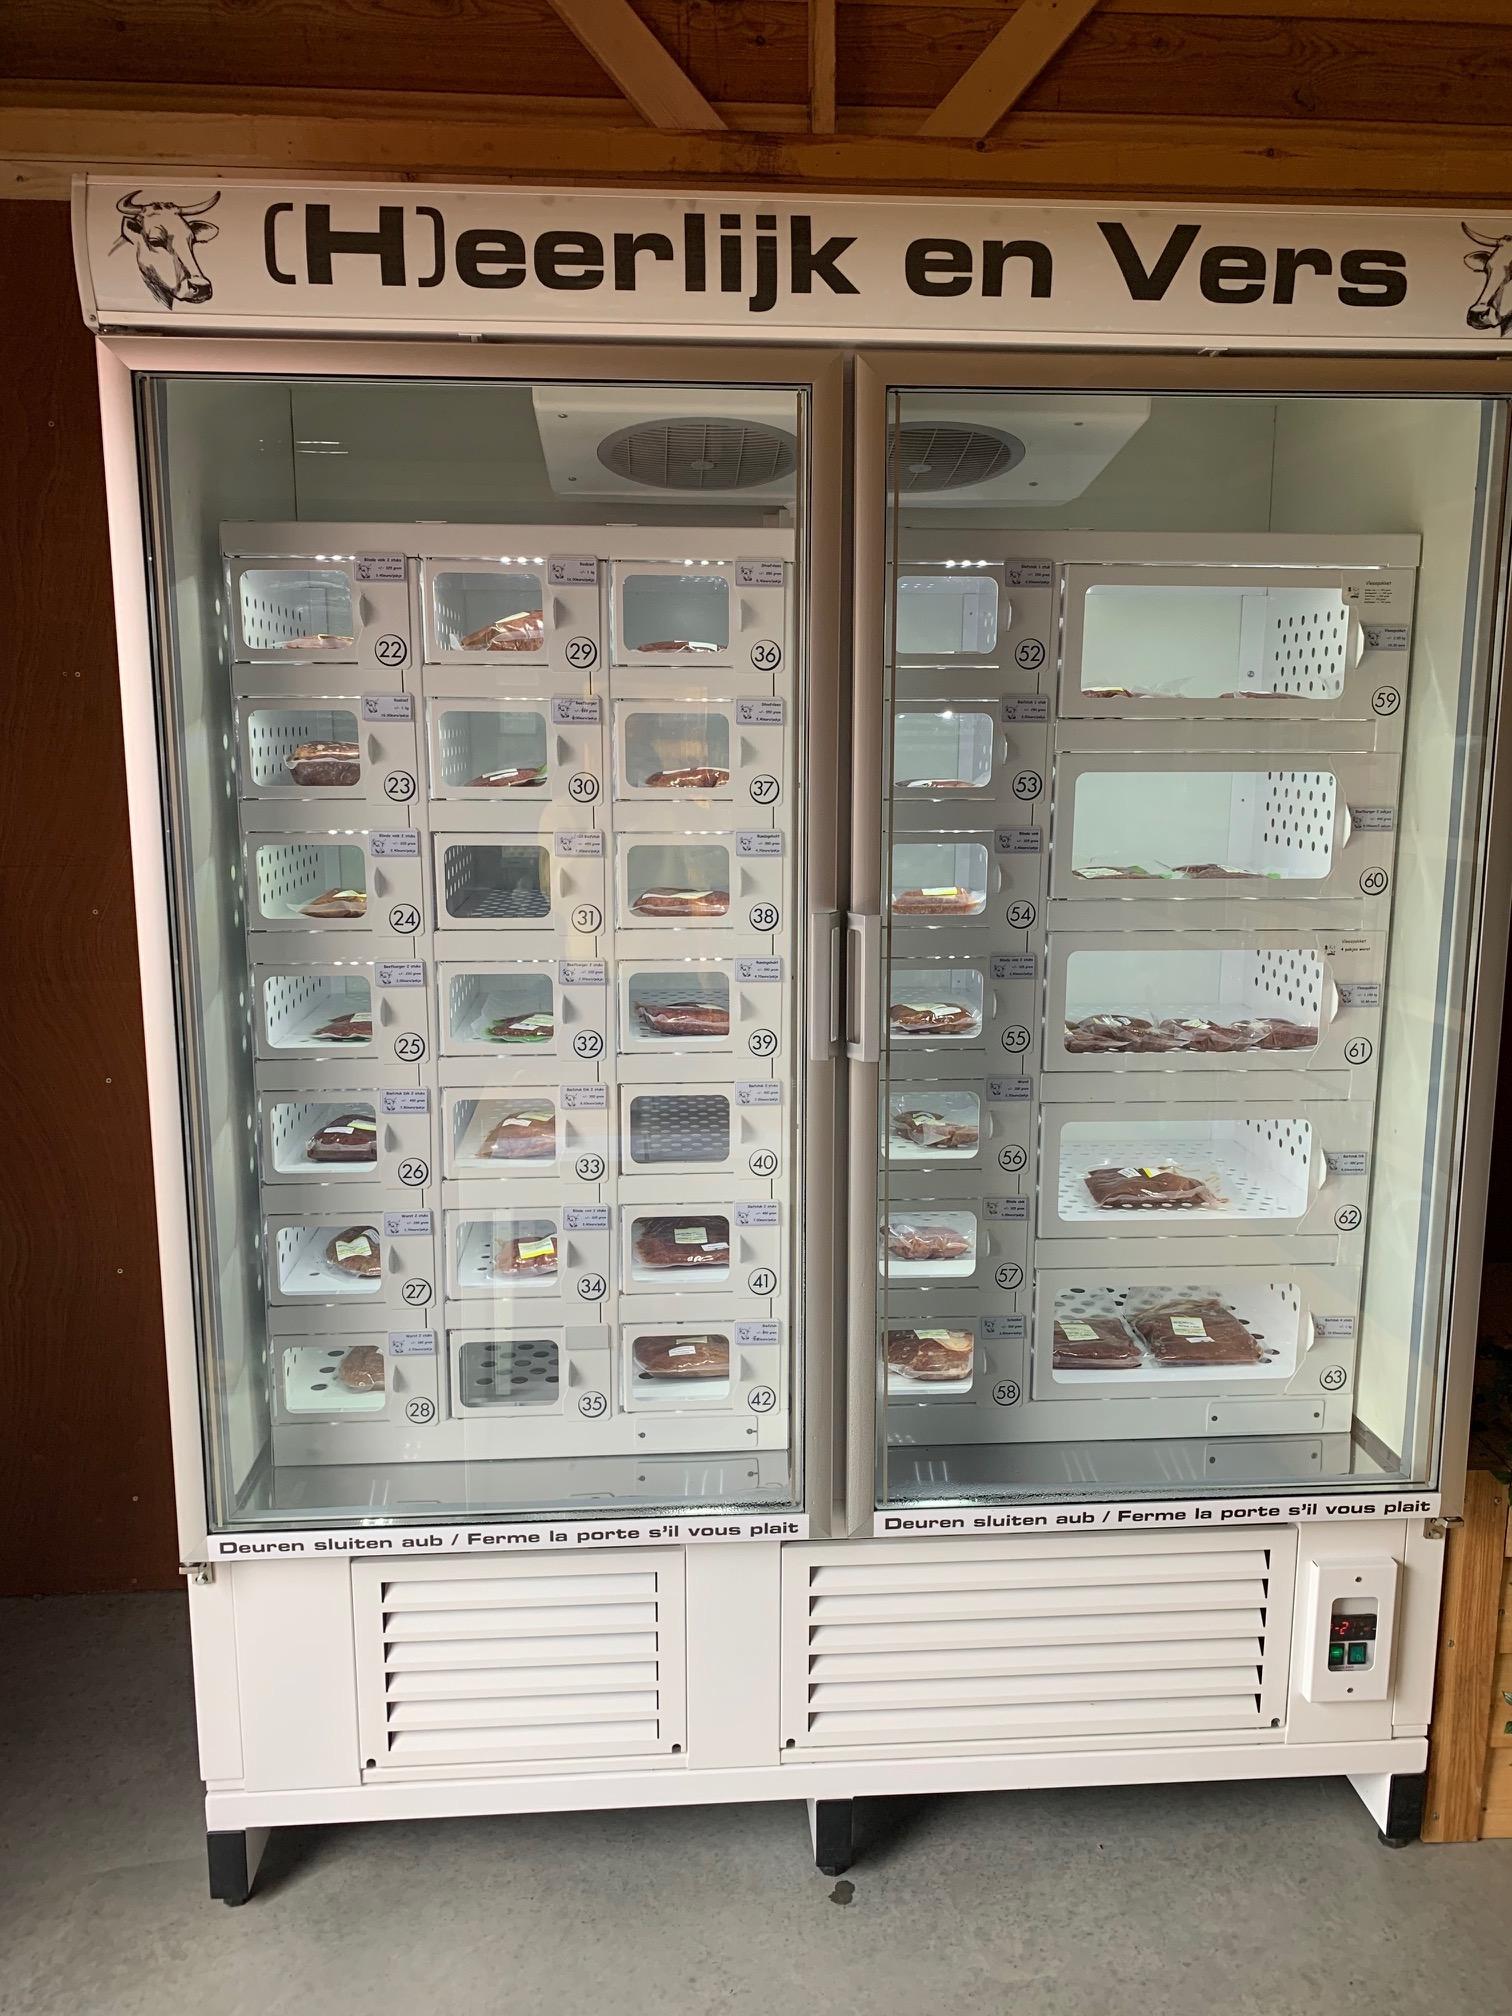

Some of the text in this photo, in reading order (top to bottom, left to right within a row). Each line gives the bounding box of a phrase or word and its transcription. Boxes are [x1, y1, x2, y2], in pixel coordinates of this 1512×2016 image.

[904, 236, 1053, 298] en
[1096, 221, 1408, 308] Vers
[378, 639, 402, 658] 22
[570, 641, 592, 660] 29
[754, 644, 776, 663] 36
[1018, 644, 1041, 662] 52
[1374, 691, 1396, 708] 59
[388, 775, 410, 794] 23
[572, 777, 595, 796] 30
[753, 779, 774, 796] 37
[1016, 775, 1038, 793] 53
[1364, 871, 1384, 888] 60
[393, 909, 416, 926] 24
[577, 909, 594, 926] 31
[753, 907, 774, 924] 38
[1010, 905, 1032, 922] 54
[398, 1037, 420, 1054] 25
[577, 1035, 598, 1052] 32
[752, 1033, 773, 1050] 39
[1005, 1029, 1026, 1046] 55
[1349, 1041, 1365, 1058] 61
[579, 1157, 600, 1174] 33
[752, 1154, 774, 1170] 40
[1002, 1149, 1022, 1165] 56
[402, 1163, 424, 1179] 26
[1338, 1209, 1358, 1224] 62
[752, 1273, 768, 1288] 41
[998, 1267, 1019, 1283] 57
[406, 1283, 426, 1299] 27
[581, 1277, 602, 1294] 34
[1324, 1369, 1342, 1384] 63
[751, 1390, 771, 1406] 42
[996, 1383, 1016, 1400] 58
[410, 1401, 430, 1417] 28
[582, 1395, 602, 1411] 35
[885, 1517, 964, 1529] Deuren
[974, 1514, 1047, 1527] sluiten
[1056, 1511, 1095, 1524] aub
[1118, 1509, 1186, 1522] Ferme
[1195, 1508, 1212, 1520] la
[1221, 1505, 1280, 1521] porte
[1288, 1503, 1317, 1516] s'il
[1326, 1504, 1376, 1515] vous
[1384, 1500, 1431, 1515] plait
[219, 1541, 304, 1554] Deuren
[314, 1537, 393, 1551] sluiten
[402, 1534, 443, 1548] aub
[468, 1532, 540, 1545] Ferme
[550, 1530, 568, 1542] la
[577, 1528, 640, 1543] porte
[649, 1525, 679, 1538] s'il
[688, 1526, 741, 1537] vous
[750, 1522, 799, 1537] plait
